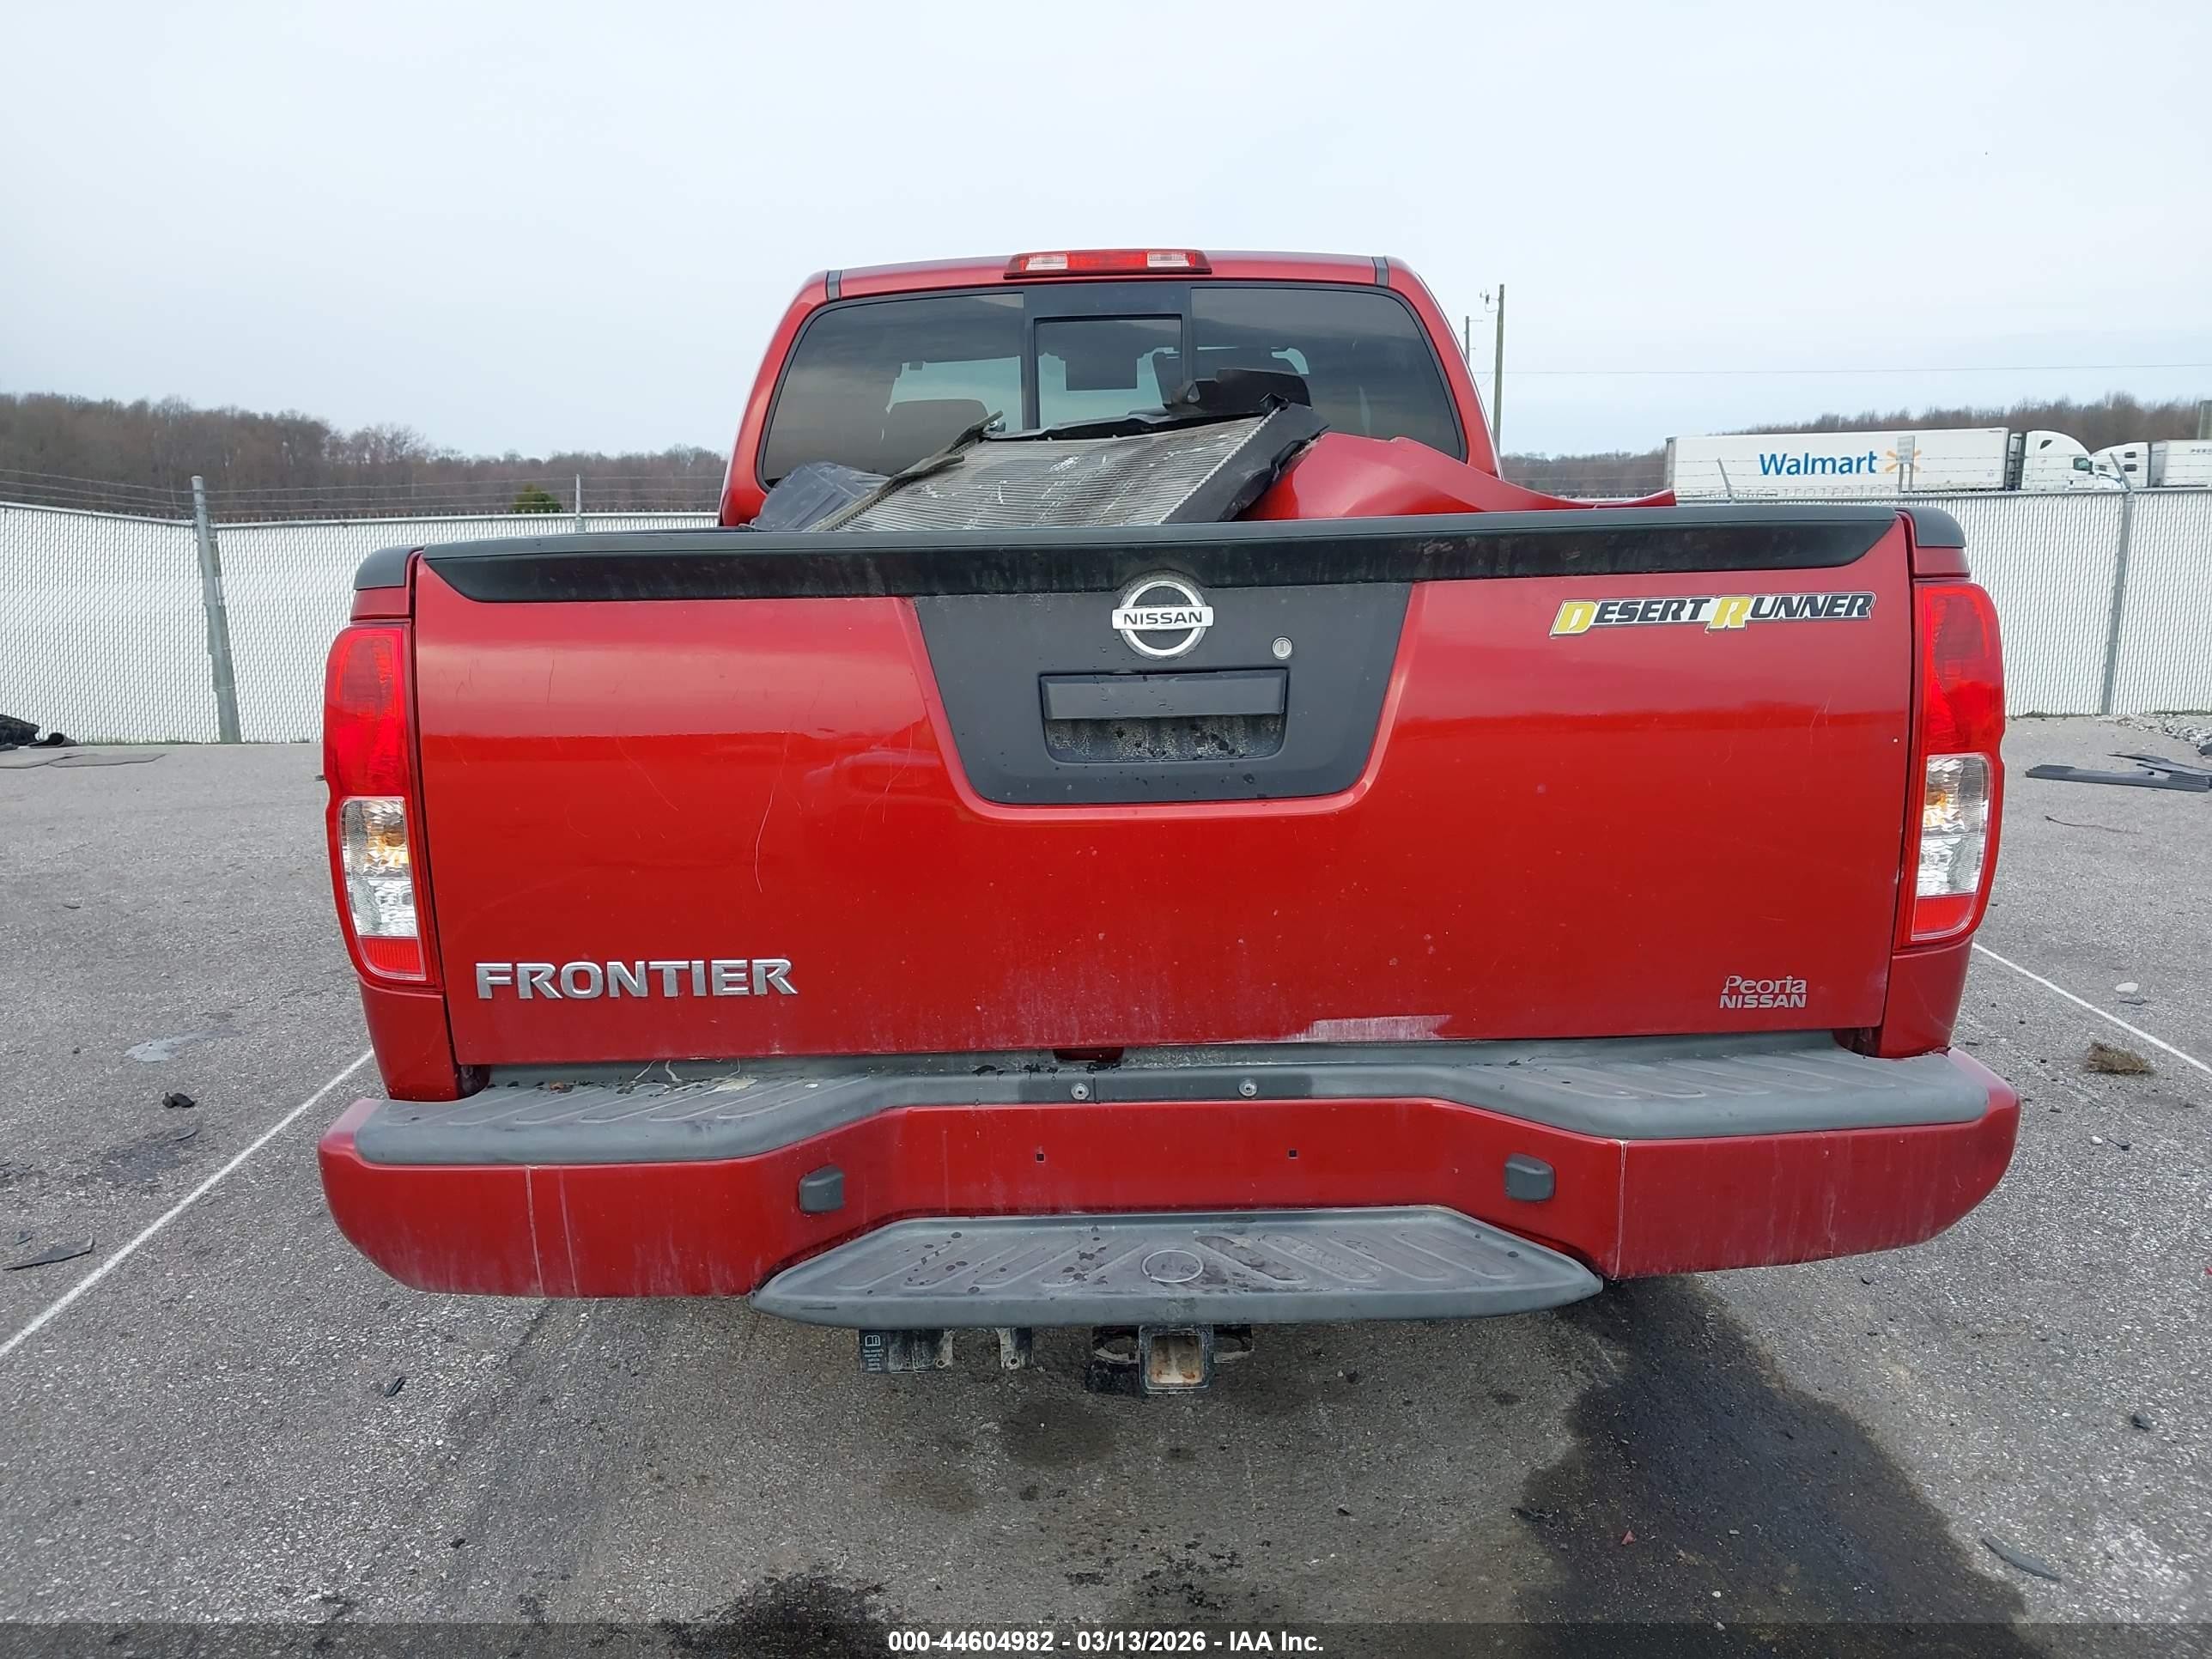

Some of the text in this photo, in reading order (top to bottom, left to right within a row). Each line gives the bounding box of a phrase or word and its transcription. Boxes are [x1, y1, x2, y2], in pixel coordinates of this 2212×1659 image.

[1759, 451, 1877, 476] Walmart
[1123, 611, 1202, 625] NISSAN
[1552, 593, 1875, 634] DESERT RUNNER
[475, 957, 799, 1001] FRONTIER
[1723, 975, 1807, 994] Peoria
[1719, 994, 1807, 1009] NISSAN
